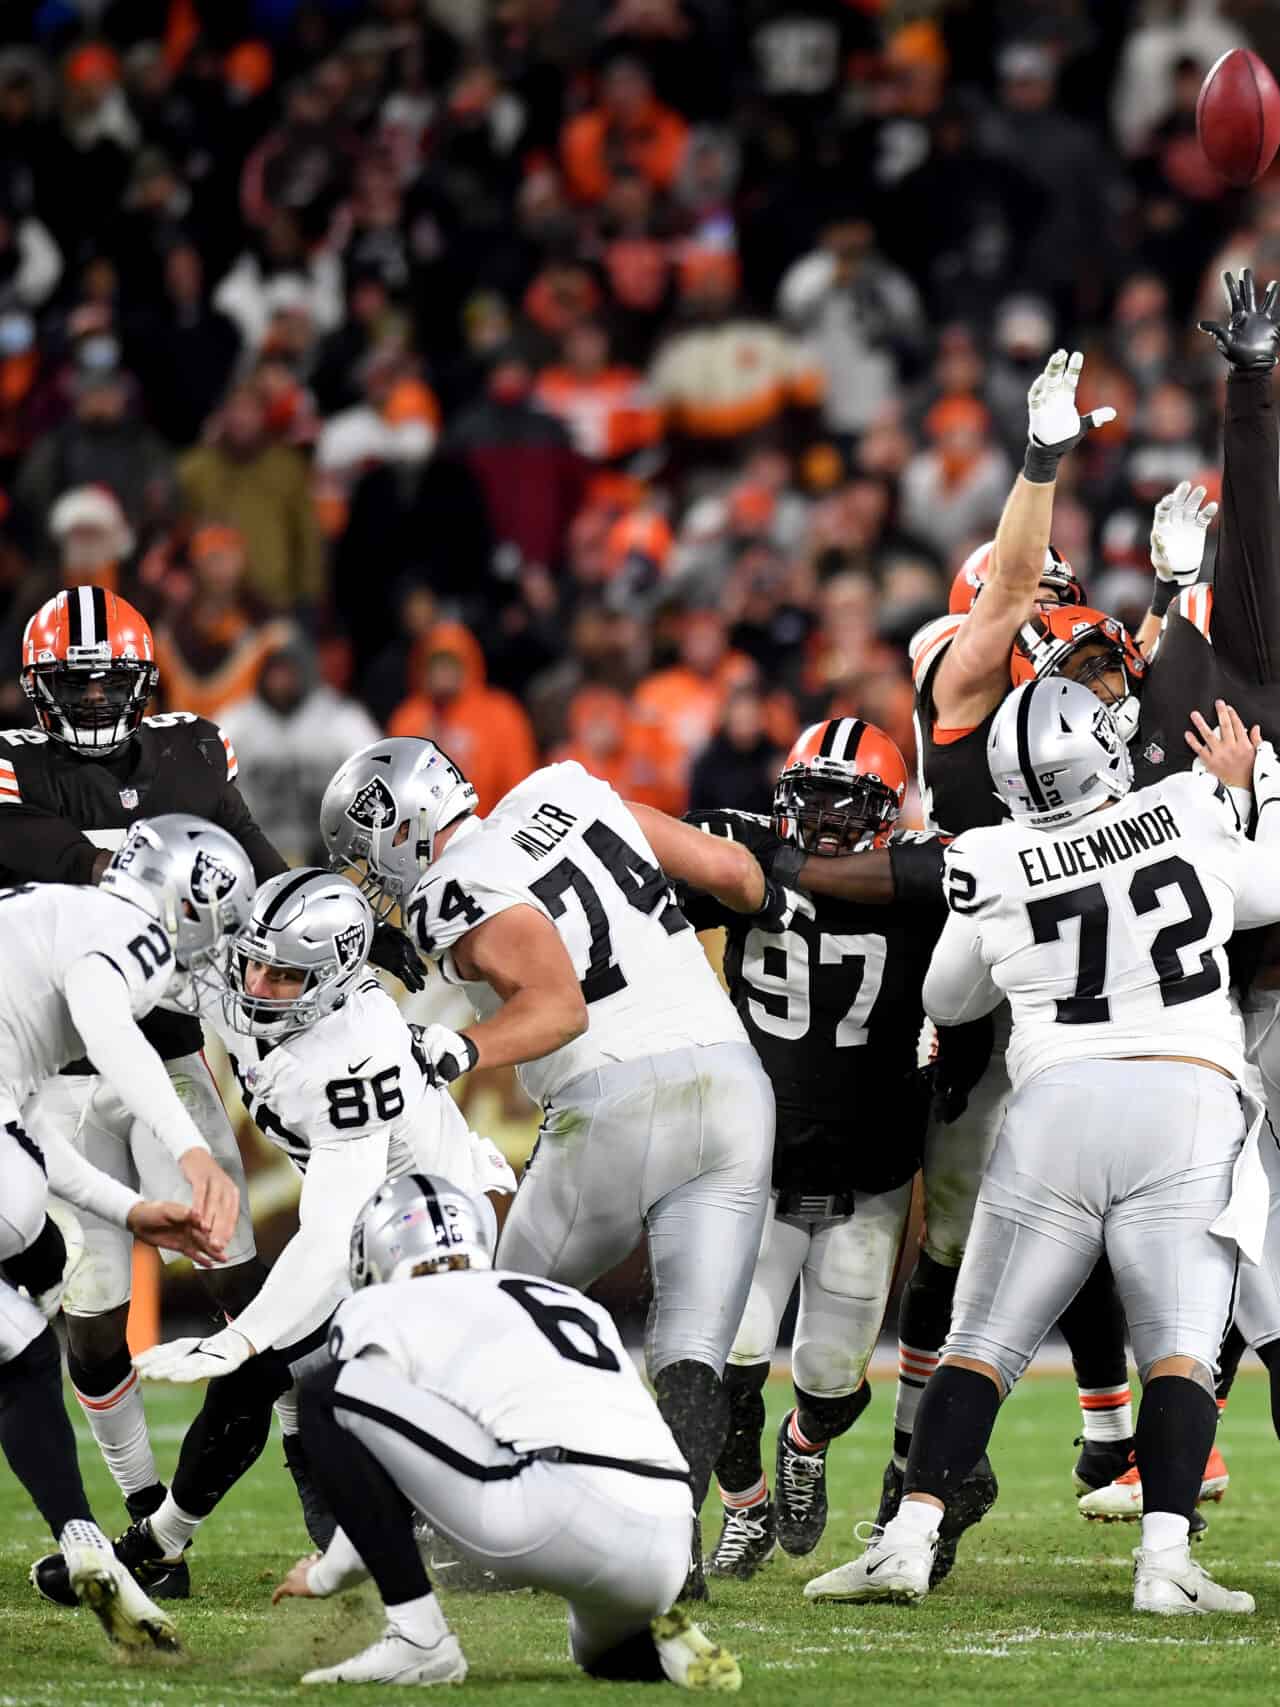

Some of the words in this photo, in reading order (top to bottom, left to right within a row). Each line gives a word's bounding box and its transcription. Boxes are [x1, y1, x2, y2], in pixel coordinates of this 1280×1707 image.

[1019, 789, 1064, 813] 72
[1018, 804, 1182, 887] ELUEMUNOR
[127, 922, 172, 980] 2
[406, 878, 487, 954] 74
[528, 818, 691, 1006] 74
[1025, 855, 1222, 1025] 72
[741, 927, 888, 1048] 97
[325, 1065, 404, 1130] 86
[497, 1279, 621, 1373] 6
